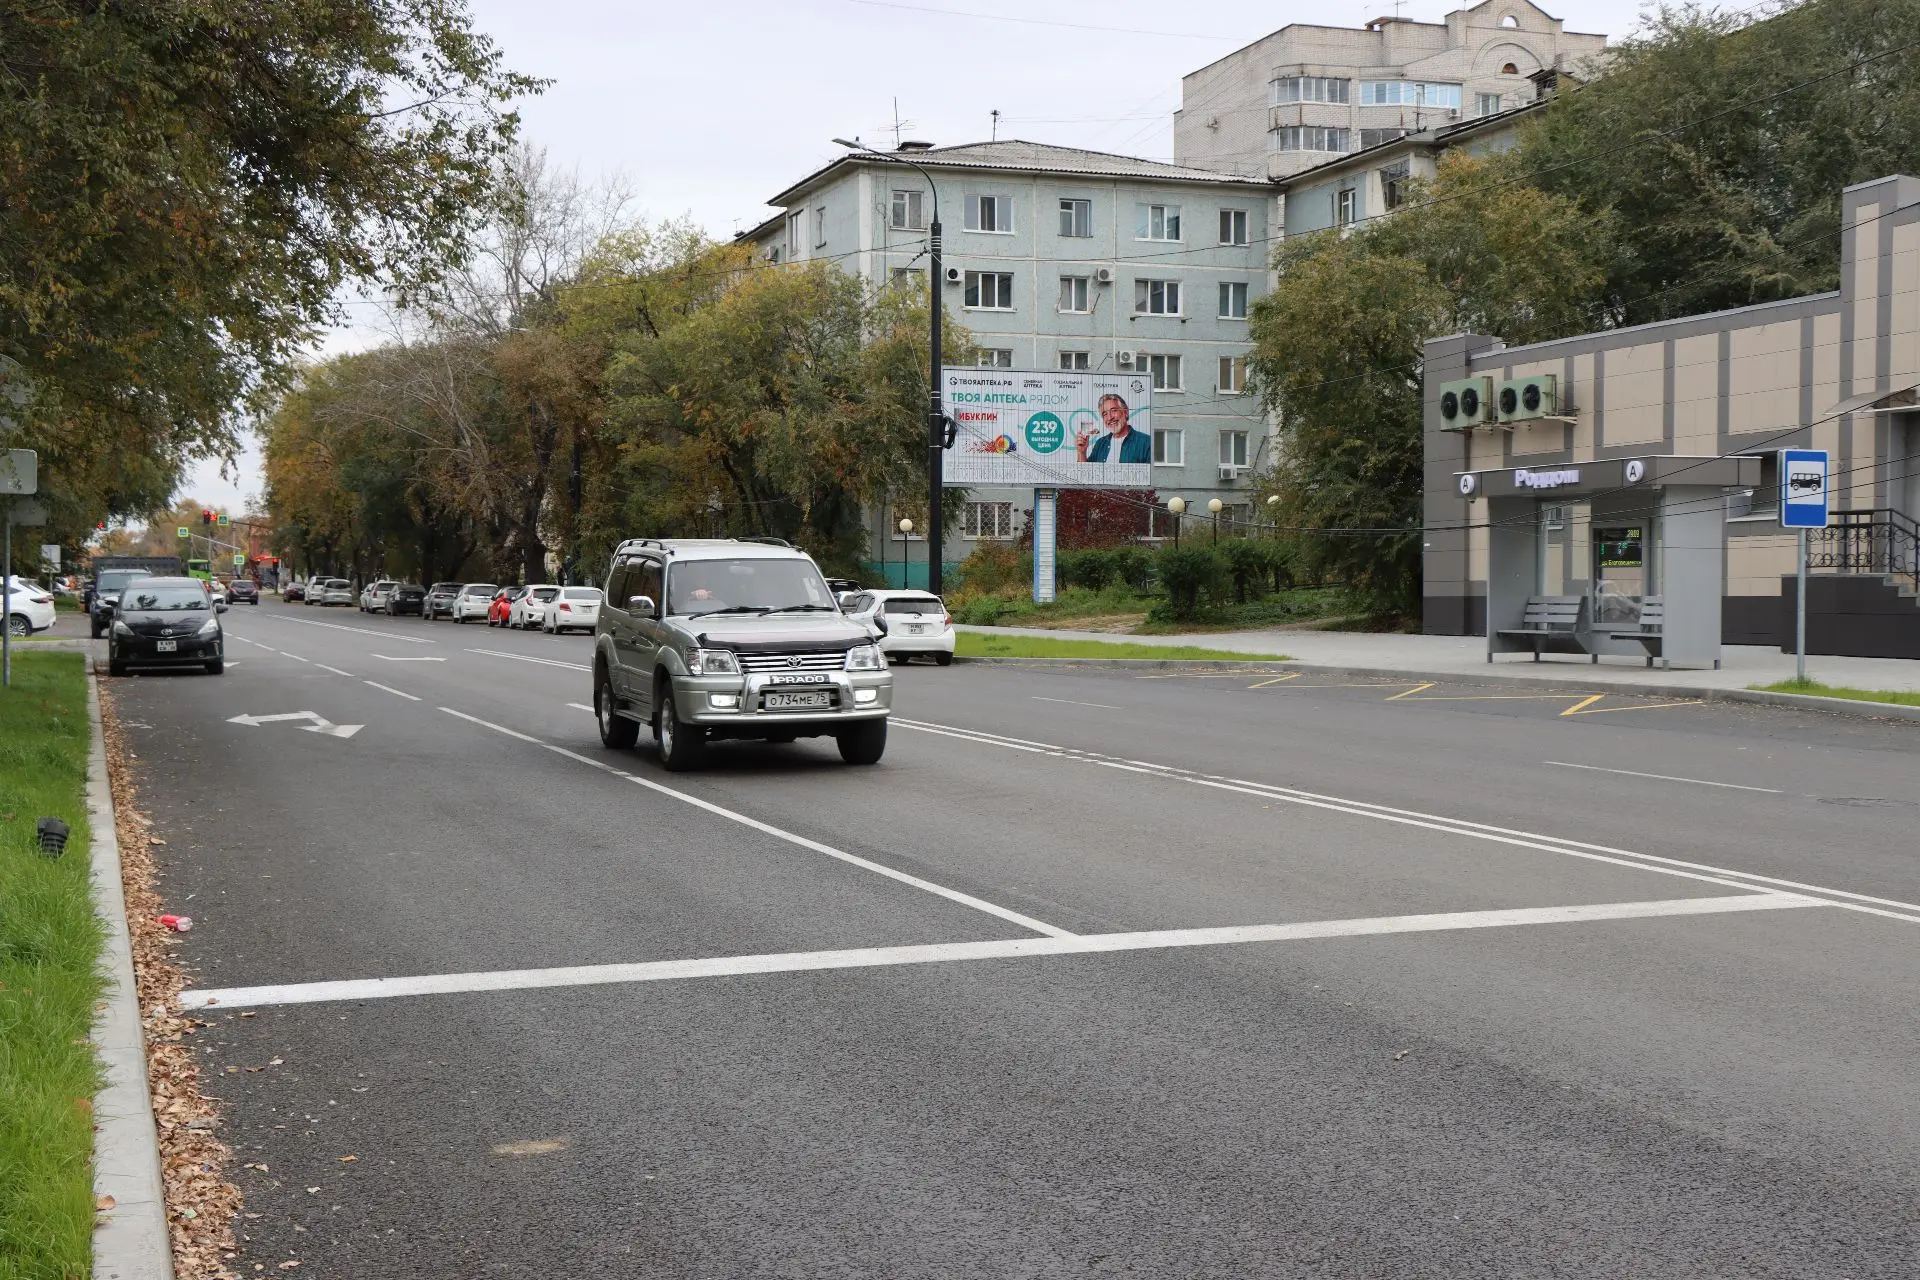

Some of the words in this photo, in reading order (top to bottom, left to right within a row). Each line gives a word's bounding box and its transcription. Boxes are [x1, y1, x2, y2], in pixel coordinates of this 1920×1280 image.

[958, 378, 1013, 387] ТВОЯАПТЕКА.РФ
[951, 392, 981, 403] ТВОЯ
[984, 393, 1027, 404] АПТЕКА
[1029, 394, 1069, 405] РЯДОМ
[959, 412, 998, 421] ИБУКЛИН
[1031, 420, 1058, 434] 239
[1514, 469, 1580, 489] Роддом
[773, 674, 825, 684] PRADO
